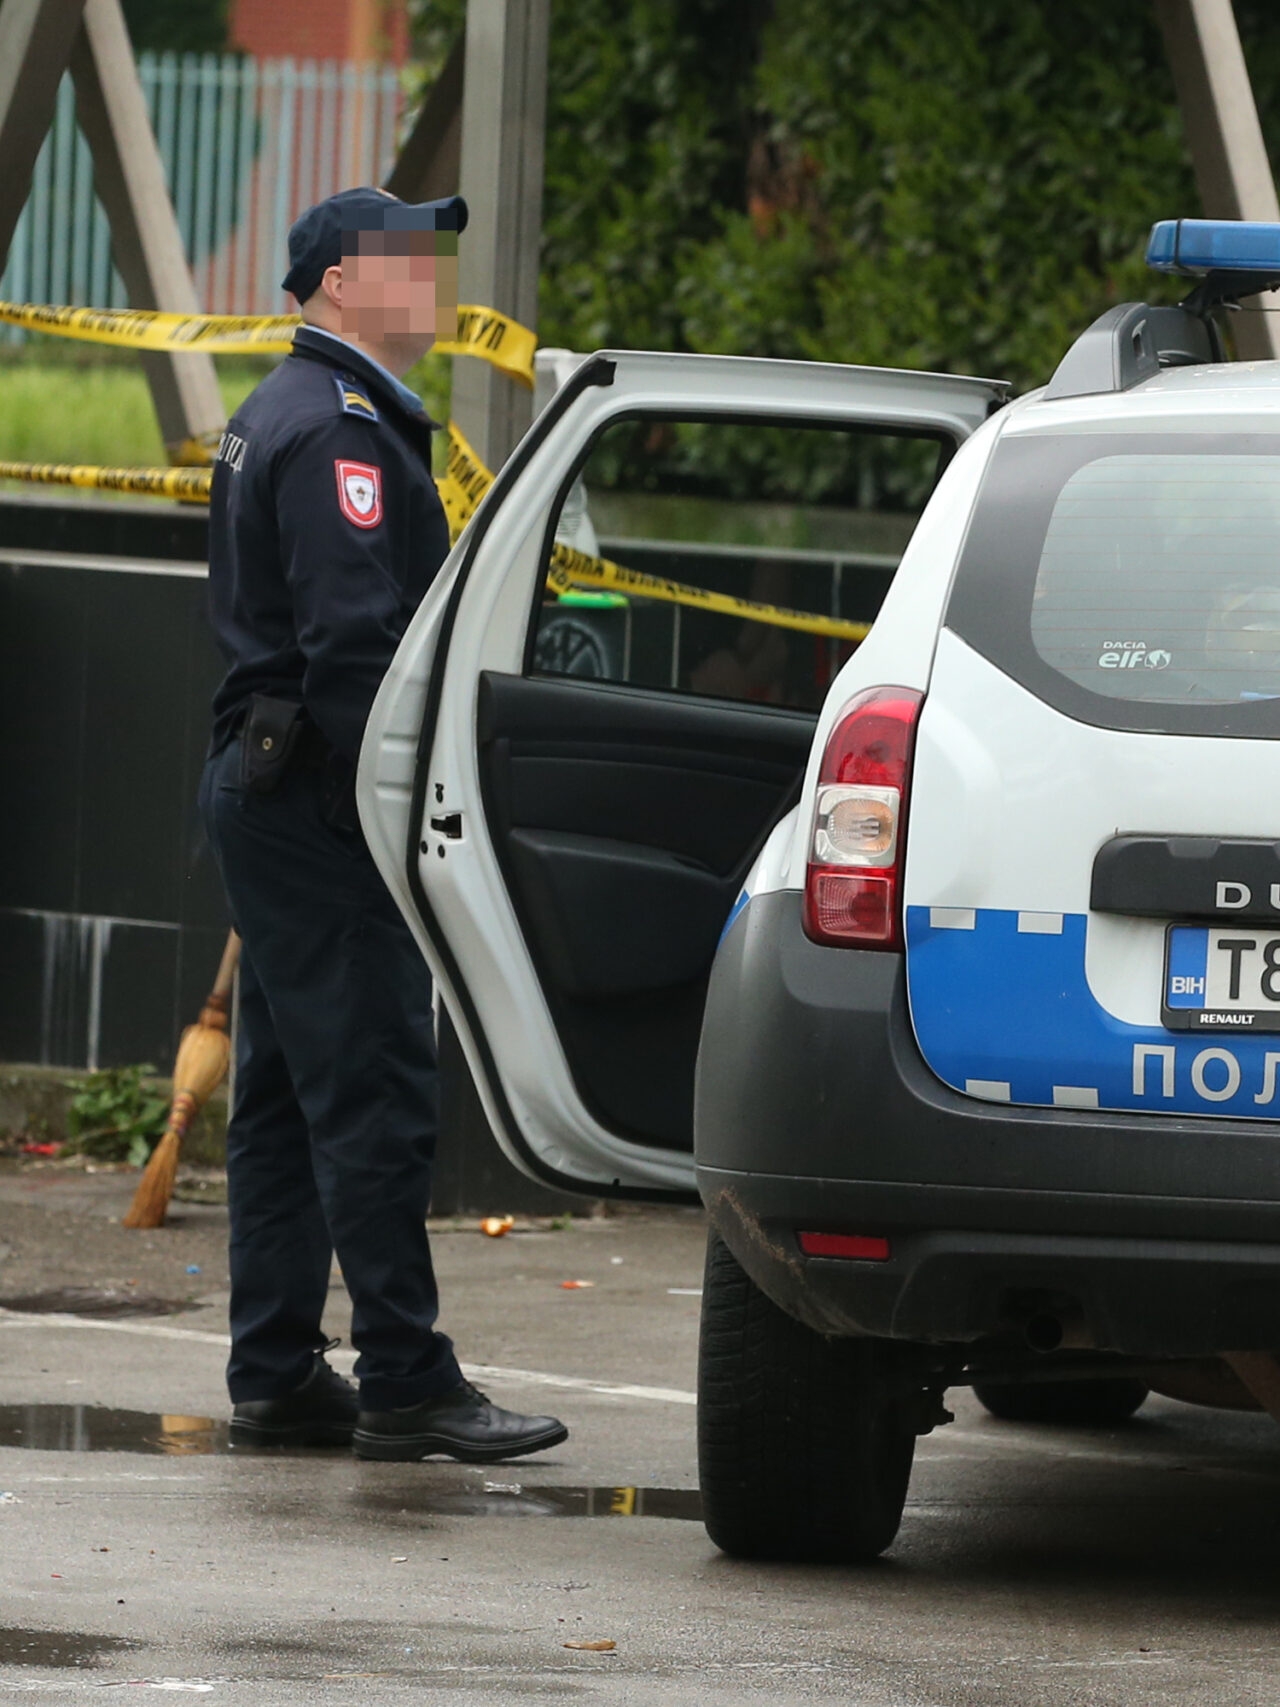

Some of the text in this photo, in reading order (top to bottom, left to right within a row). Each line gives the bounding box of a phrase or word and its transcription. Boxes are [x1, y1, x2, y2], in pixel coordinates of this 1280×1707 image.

[1103, 641, 1147, 649] DACIA
[1098, 650, 1146, 668] elf
[1171, 976, 1204, 994] BIH
[1199, 1014, 1255, 1025] RENAULT
